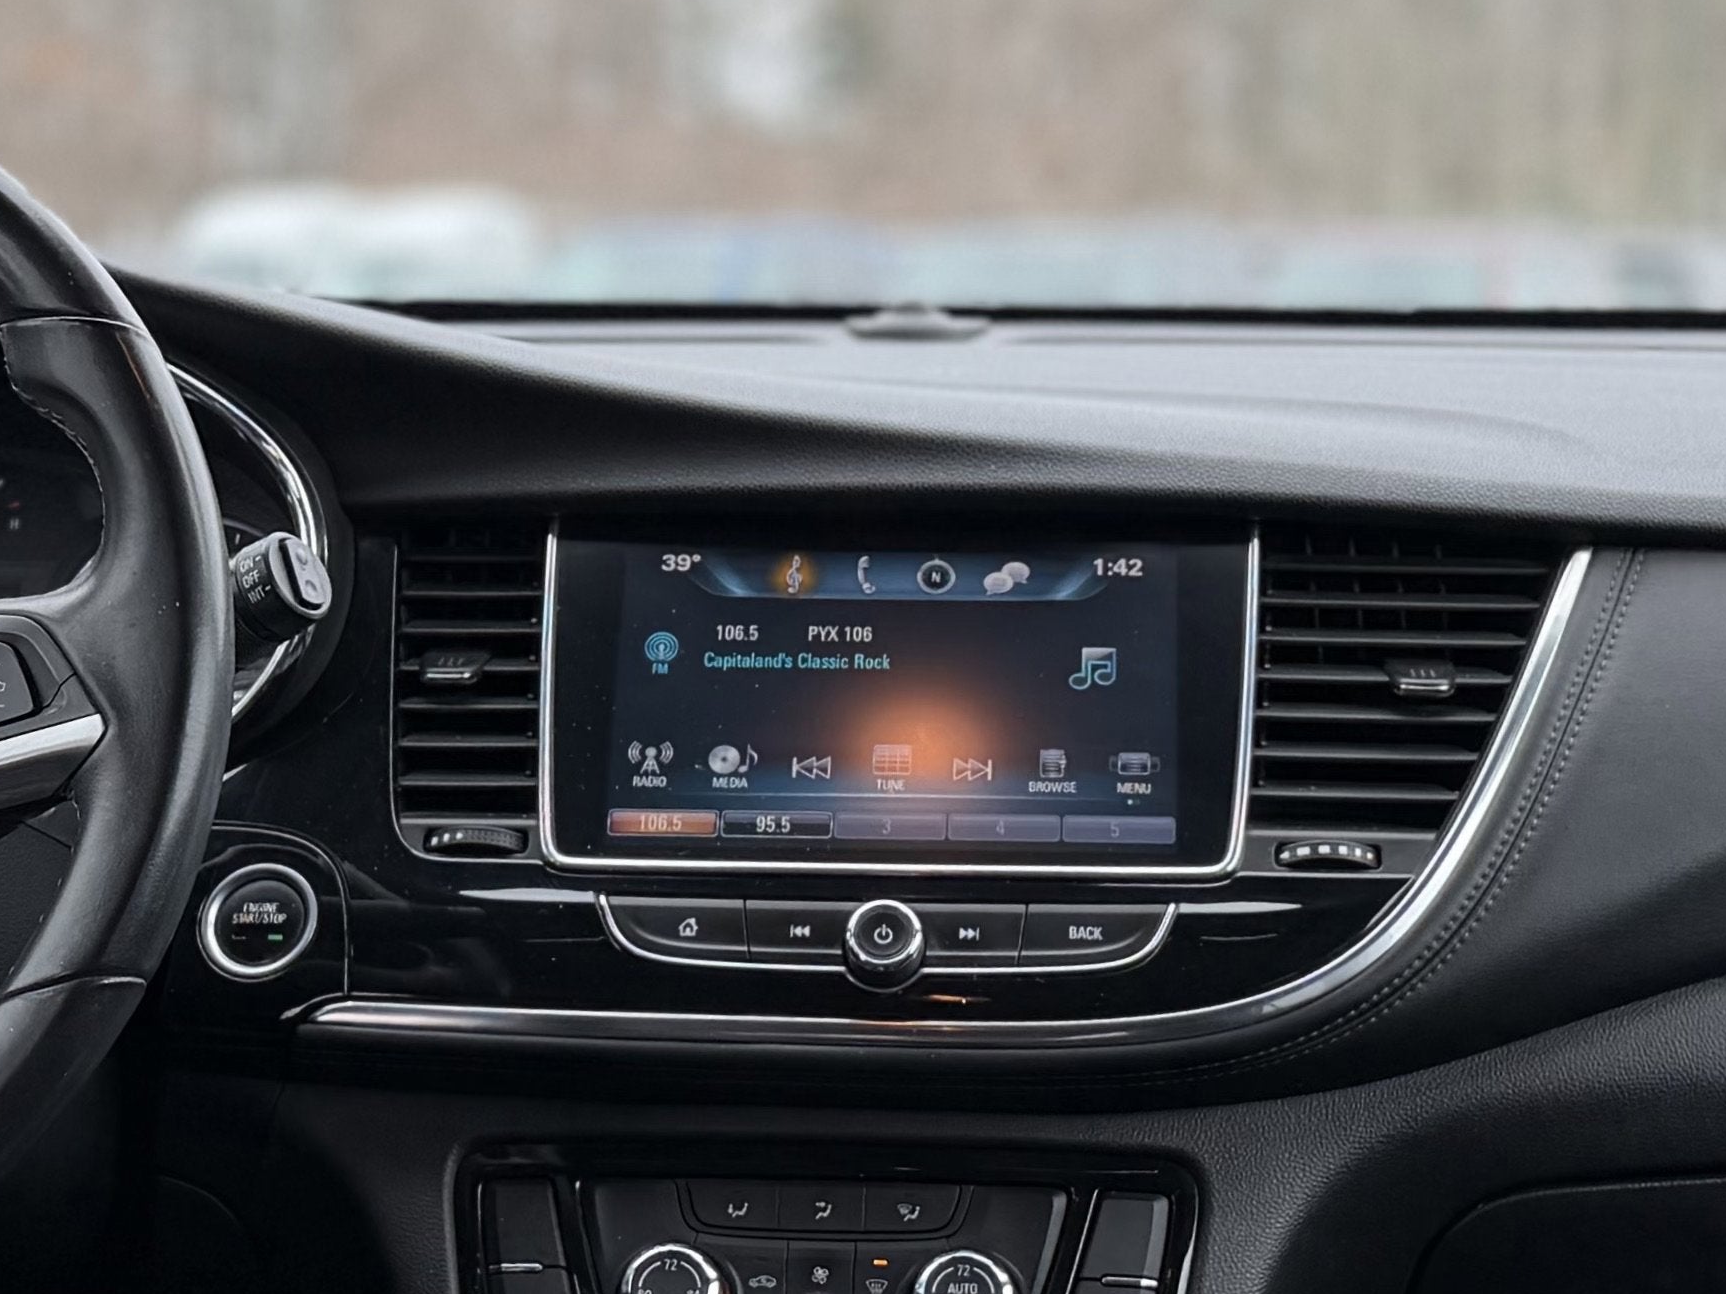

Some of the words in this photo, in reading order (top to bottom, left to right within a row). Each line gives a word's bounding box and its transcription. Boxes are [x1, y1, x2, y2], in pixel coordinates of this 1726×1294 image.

[1093, 557, 1144, 577] 1:42
[716, 624, 760, 642] 106.5
[808, 625, 839, 642] PYX
[844, 626, 873, 643] 106
[651, 662, 669, 675] FM
[703, 651, 793, 671] Capitaland's
[797, 652, 849, 670] Classic
[853, 653, 891, 670] Rock
[632, 775, 667, 789] RADIO
[711, 776, 749, 789] MEDIA
[876, 779, 906, 792] TUNE
[1028, 780, 1077, 794] BROWSE
[1116, 782, 1152, 795] MENU
[639, 814, 682, 832] 106.5
[756, 815, 791, 834] 95.5
[882, 818, 891, 835] 3
[995, 819, 1005, 836] 4
[1110, 821, 1120, 838] 5
[1068, 925, 1103, 941] BACK
[664, 1258, 678, 1272] 72
[957, 1264, 970, 1277] 72
[947, 1282, 978, 1294] AUTO
